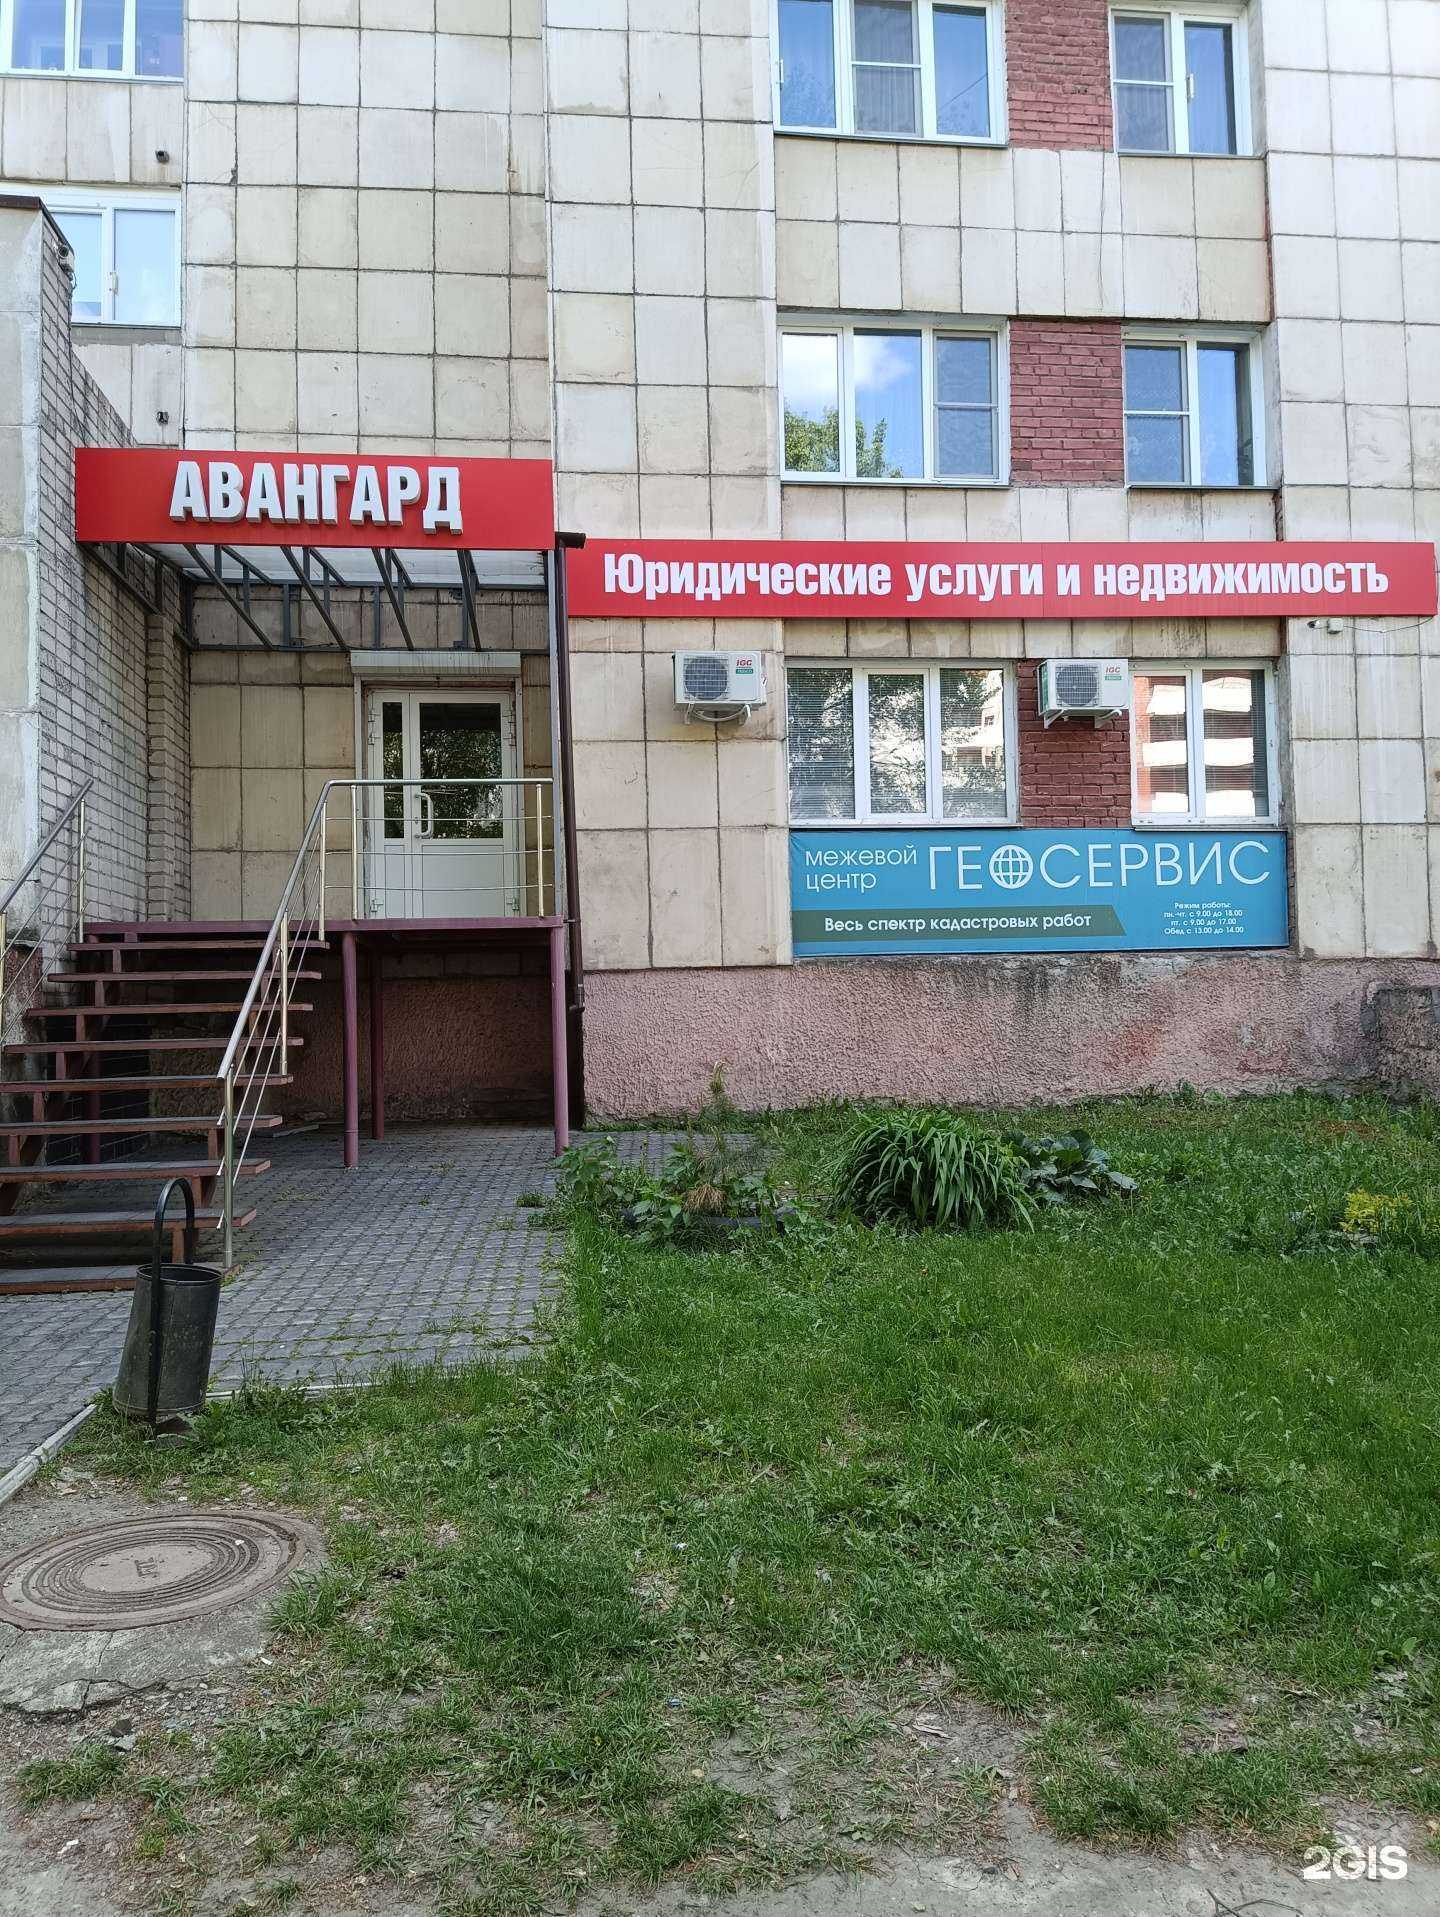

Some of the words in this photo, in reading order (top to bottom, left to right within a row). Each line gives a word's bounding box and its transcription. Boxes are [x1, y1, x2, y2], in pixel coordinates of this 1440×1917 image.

[169, 461, 464, 535] АВАНГАРД
[604, 552, 892, 601] Юридические
[905, 562, 1044, 602] услуги
[1056, 563, 1081, 596] и
[1093, 562, 1390, 602] недвижимость
[805, 844, 918, 867] межевой
[805, 872, 877, 893] центр
[824, 917, 863, 932] Весь
[868, 918, 926, 933] спектр
[930, 916, 1039, 932] кадастровых
[1043, 913, 1092, 930] работ
[1164, 927, 1185, 935] Обед
